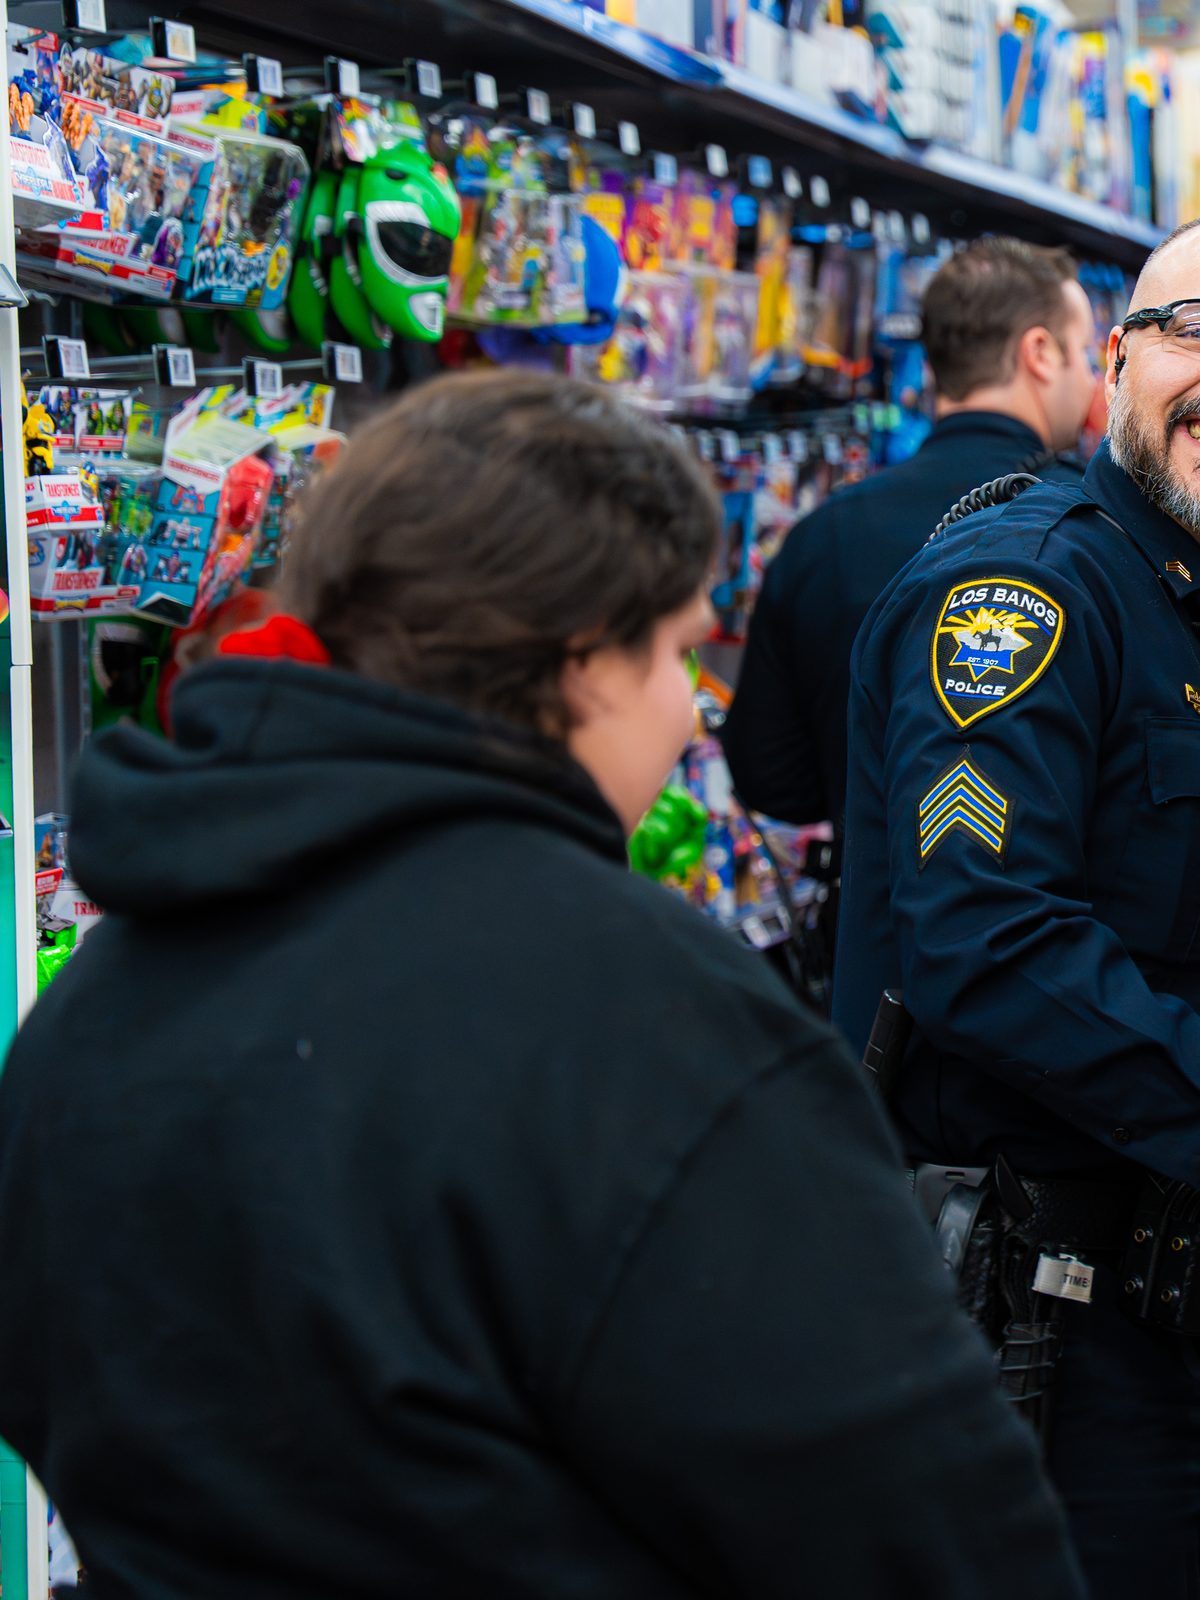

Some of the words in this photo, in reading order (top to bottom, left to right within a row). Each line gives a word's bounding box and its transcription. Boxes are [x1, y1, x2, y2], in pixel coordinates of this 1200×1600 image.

[948, 588, 989, 610] LOS
[992, 588, 1058, 627] BANOS
[967, 656, 981, 664] EST.
[982, 658, 999, 666] 1907
[945, 679, 1007, 696] POLICE
